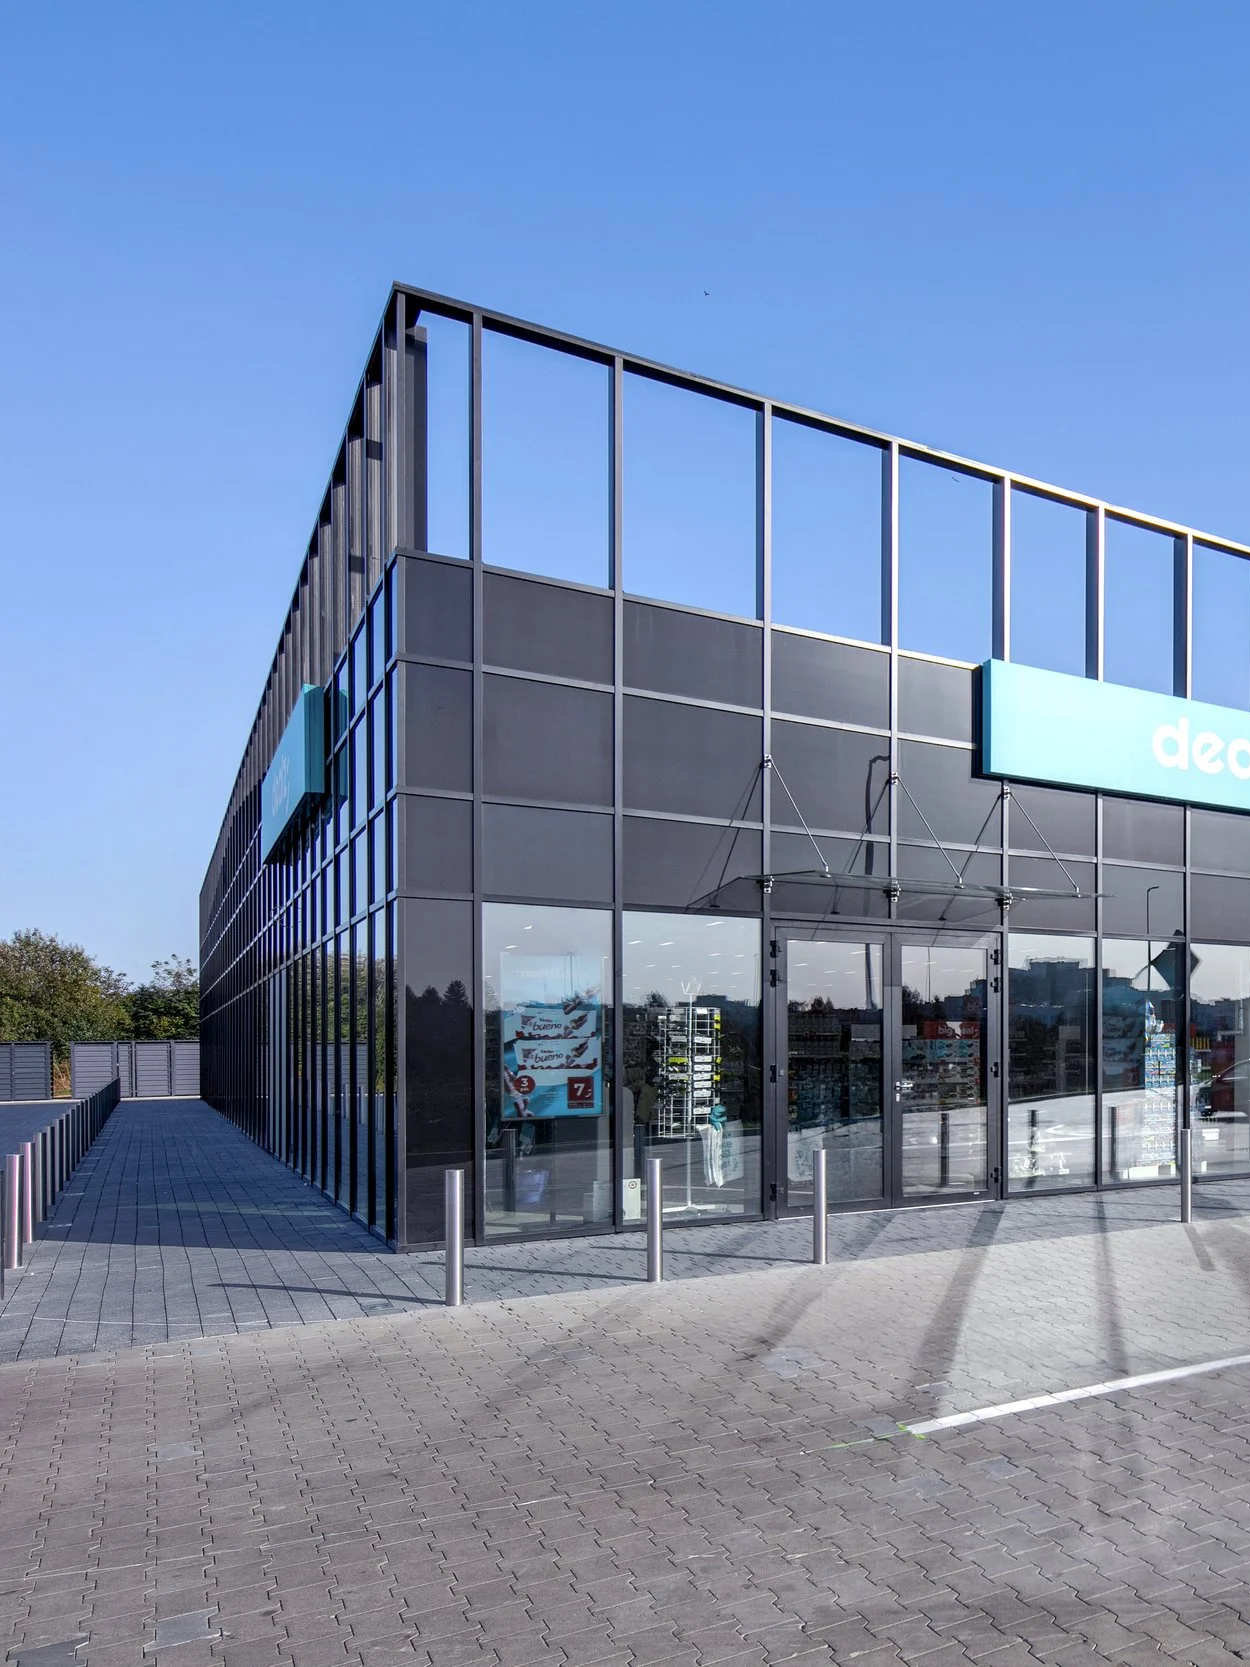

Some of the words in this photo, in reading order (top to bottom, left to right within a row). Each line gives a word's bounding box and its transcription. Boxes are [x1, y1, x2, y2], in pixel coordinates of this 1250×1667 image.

[533, 1022, 562, 1031] bueno
[938, 1025, 953, 1036] big
[961, 1026, 974, 1034] eal
[534, 1053, 564, 1064] bueno
[520, 1078, 529, 1087] 3
